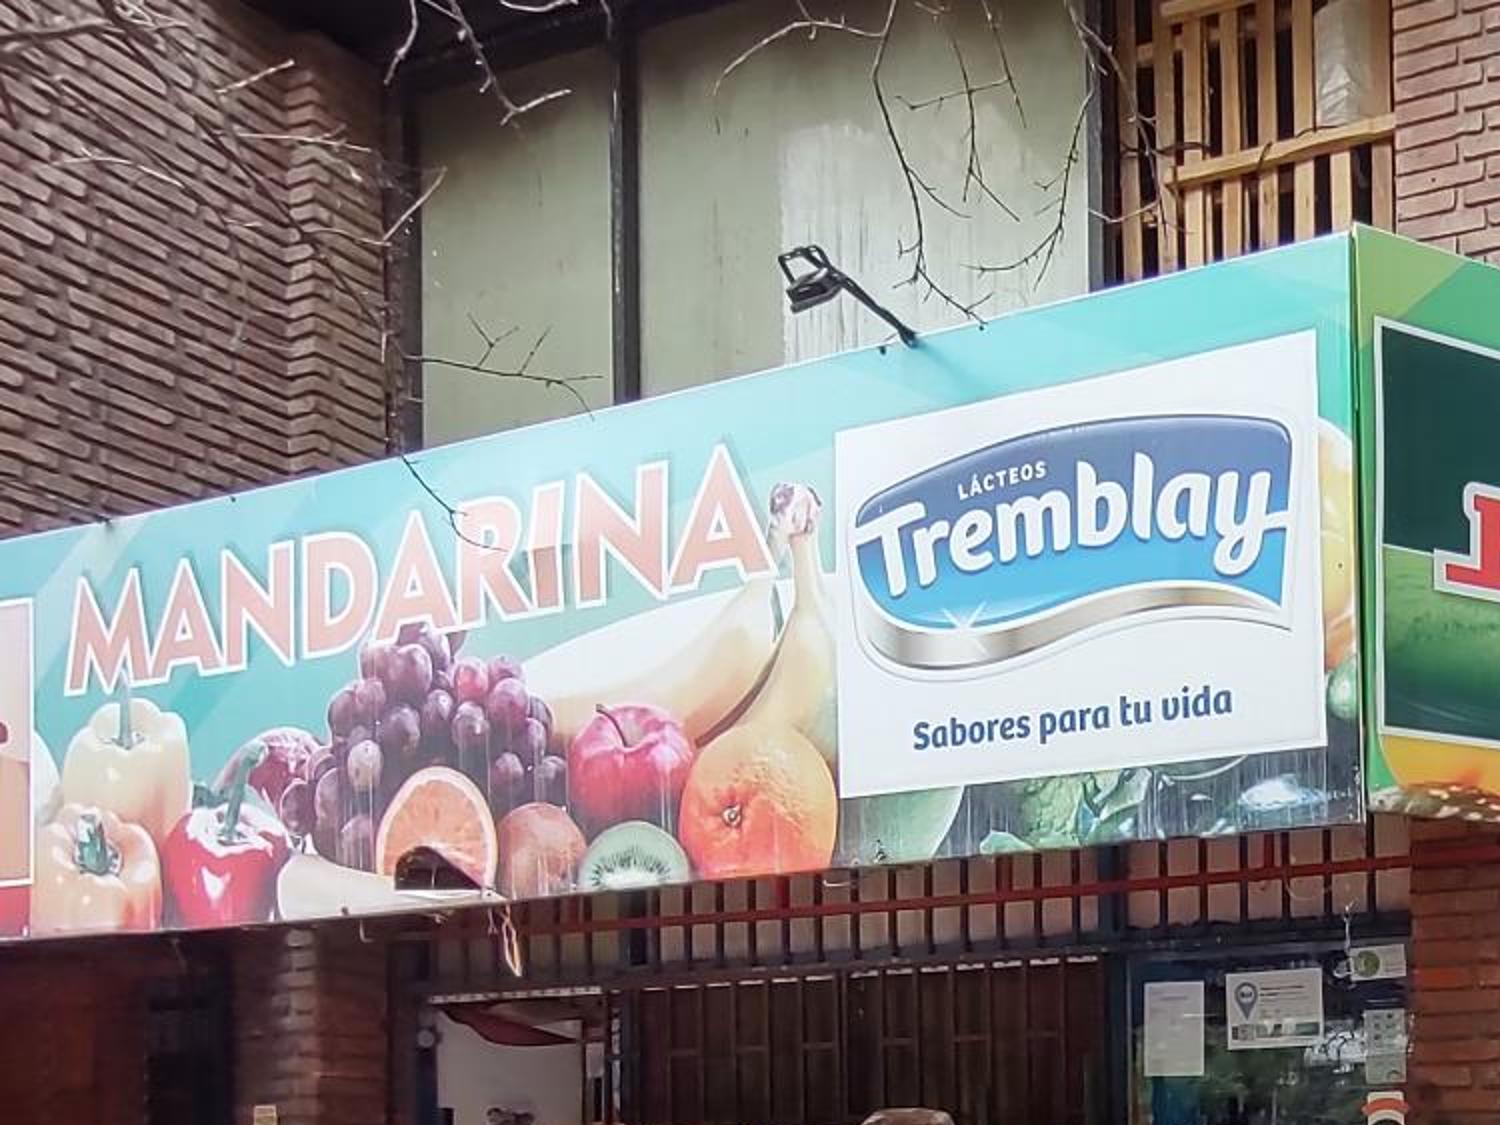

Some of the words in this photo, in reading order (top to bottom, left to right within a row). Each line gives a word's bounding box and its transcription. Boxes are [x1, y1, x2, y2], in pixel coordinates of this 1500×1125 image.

[855, 453, 1288, 598] Tremblay
[957, 460, 1047, 500] LÁCTEOS
[65, 443, 779, 697] MANDARINA
[913, 713, 1030, 752] Sabores
[1039, 702, 1110, 745] para
[1119, 694, 1151, 726] tu
[1162, 684, 1233, 720] vida
